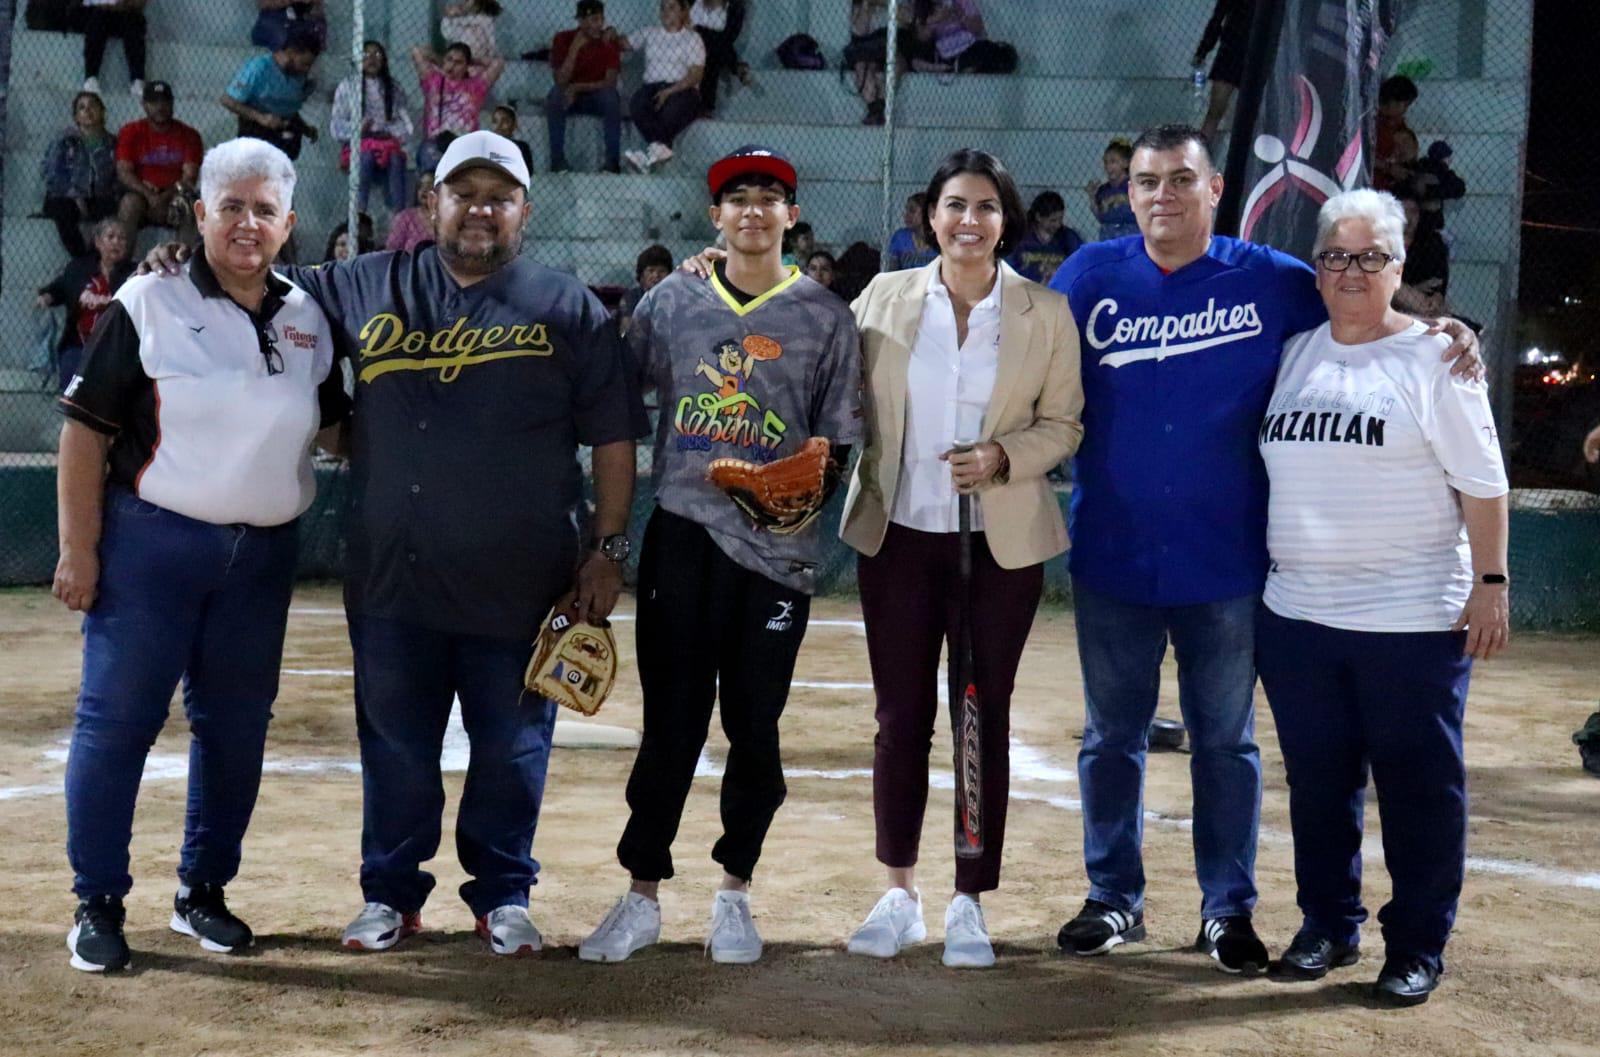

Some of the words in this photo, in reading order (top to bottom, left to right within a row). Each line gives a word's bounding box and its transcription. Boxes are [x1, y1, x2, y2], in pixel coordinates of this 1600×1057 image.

[359, 313, 554, 383] Dodgers
[1086, 298, 1262, 363] Compadres
[1259, 411, 1386, 446] MAZATLÁN
[962, 699, 981, 836] REBEL
